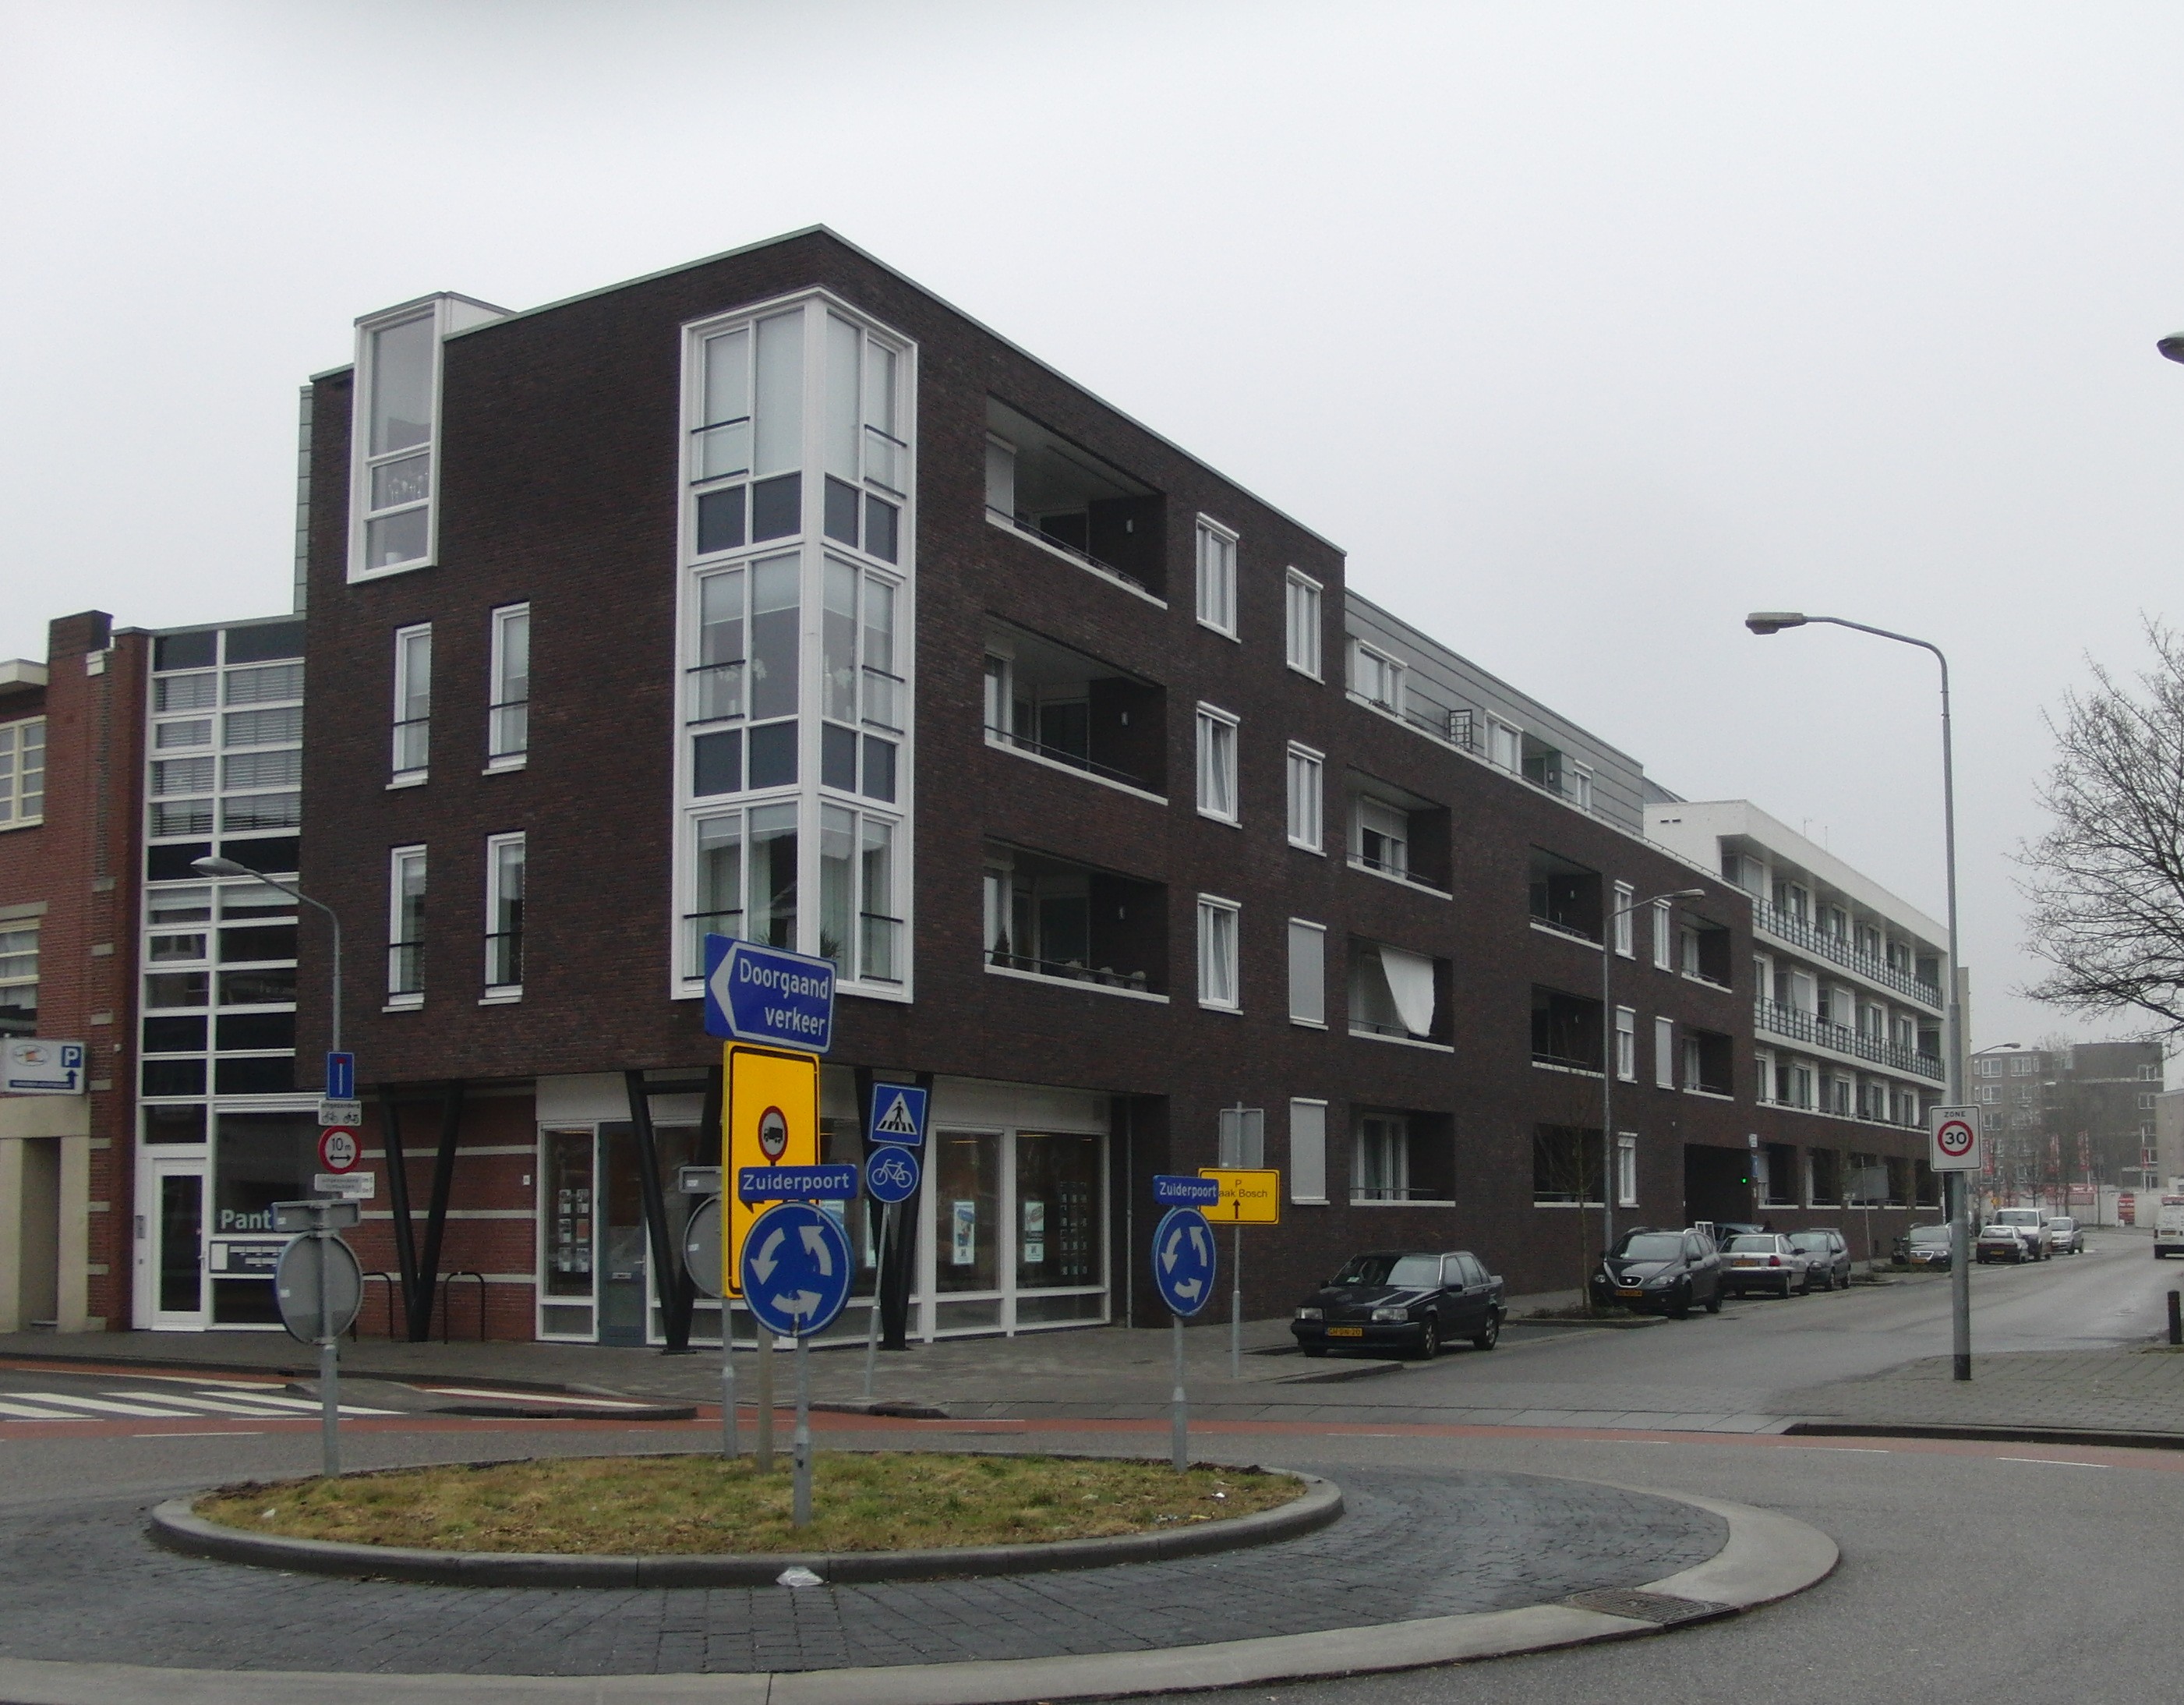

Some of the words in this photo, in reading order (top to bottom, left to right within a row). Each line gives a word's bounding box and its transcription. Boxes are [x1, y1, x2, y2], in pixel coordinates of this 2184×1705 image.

[740, 957, 829, 1000] Doorgaand
[765, 1006, 825, 1036] verkeer
[65, 1048, 79, 1066] P
[332, 1137, 343, 1151] 10
[1945, 1132, 1967, 1144] 30
[743, 1173, 850, 1192] Zuiderpoort
[1159, 1182, 1217, 1197] Zuiderpoort
[1218, 1189, 1236, 1197] aak
[1239, 1189, 1267, 1198] Bosch
[221, 1209, 272, 1229] Pant
